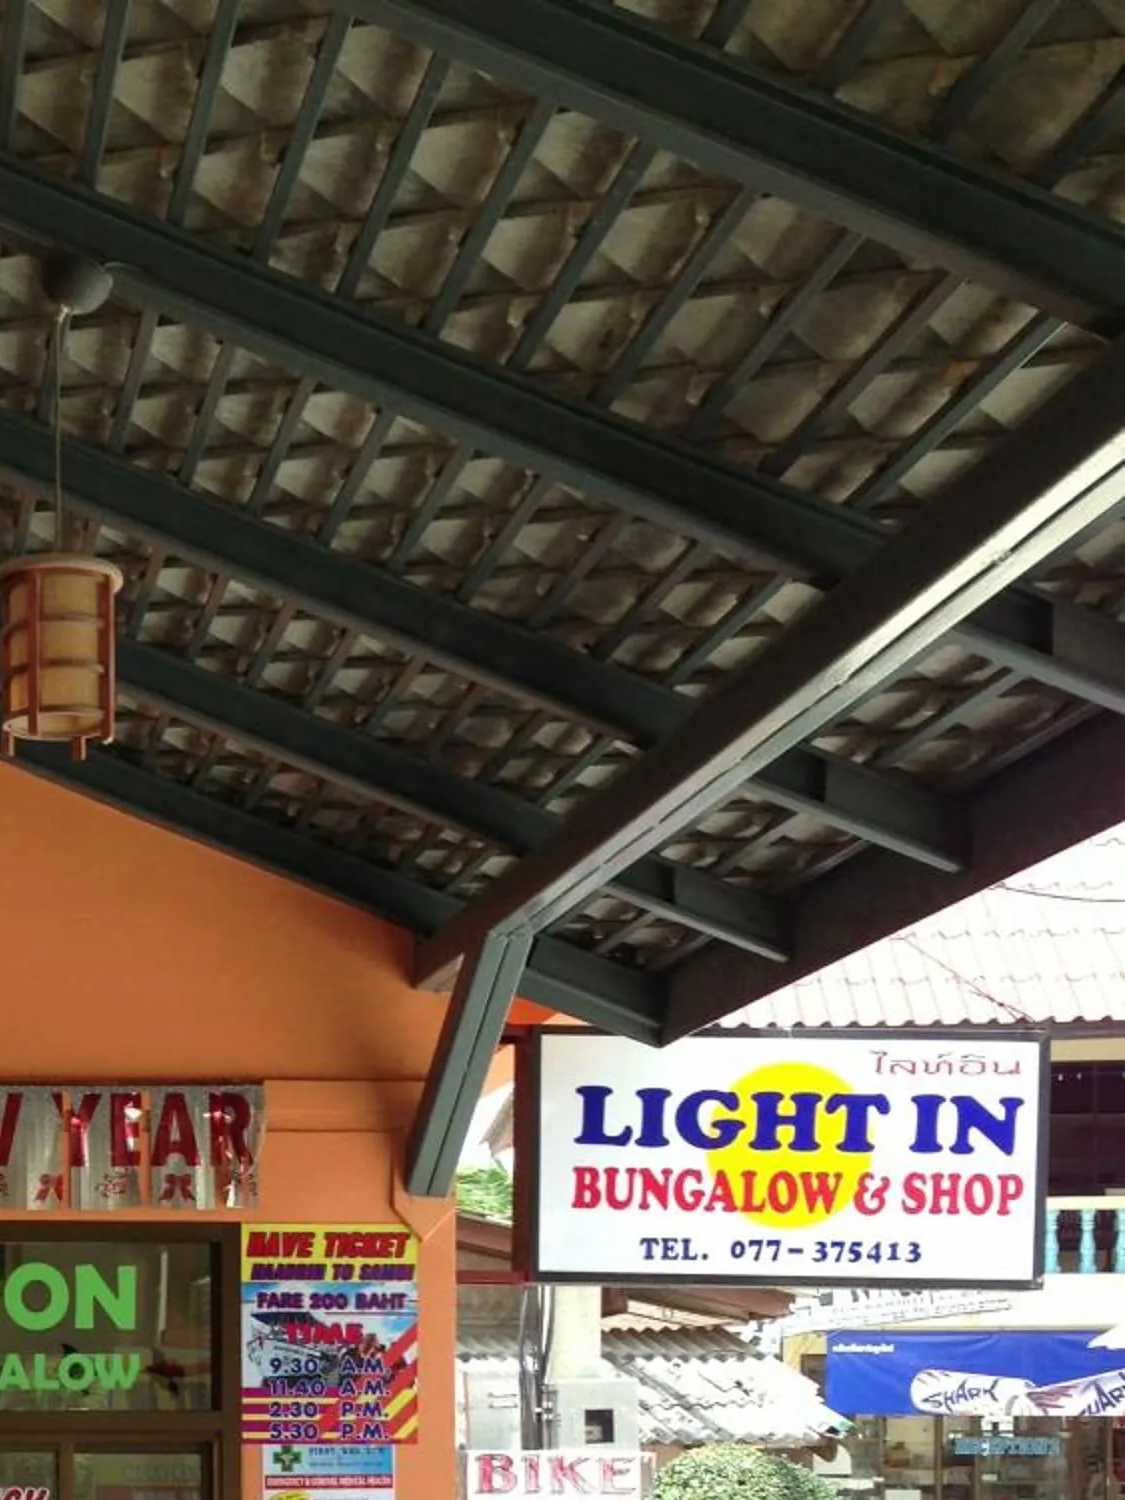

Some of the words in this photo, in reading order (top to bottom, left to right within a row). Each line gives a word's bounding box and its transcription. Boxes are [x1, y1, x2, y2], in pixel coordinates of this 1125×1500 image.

[52, 1091, 257, 1168] YEAR
[574, 1086, 891, 1154] LIGHT
[909, 1093, 1024, 1156] IN
[571, 1166, 844, 1215] BUNGALOW
[854, 1172, 892, 1216] &
[901, 1172, 1024, 1216] SHOP
[639, 1237, 709, 1262] TEL.
[256, 1291, 305, 1309] FARE
[354, 1291, 408, 1309] BAHT
[269, 1357, 319, 1375] 9.30
[341, 1356, 391, 1374] A.M.
[341, 1378, 391, 1396] A.M.
[921, 1378, 999, 1413] SHARK
[269, 1401, 319, 1418] 2.30
[341, 1401, 390, 1418] P.M.
[269, 1423, 319, 1440] 5.30
[341, 1423, 390, 1440] P.M.
[474, 1453, 636, 1495] BIKE
